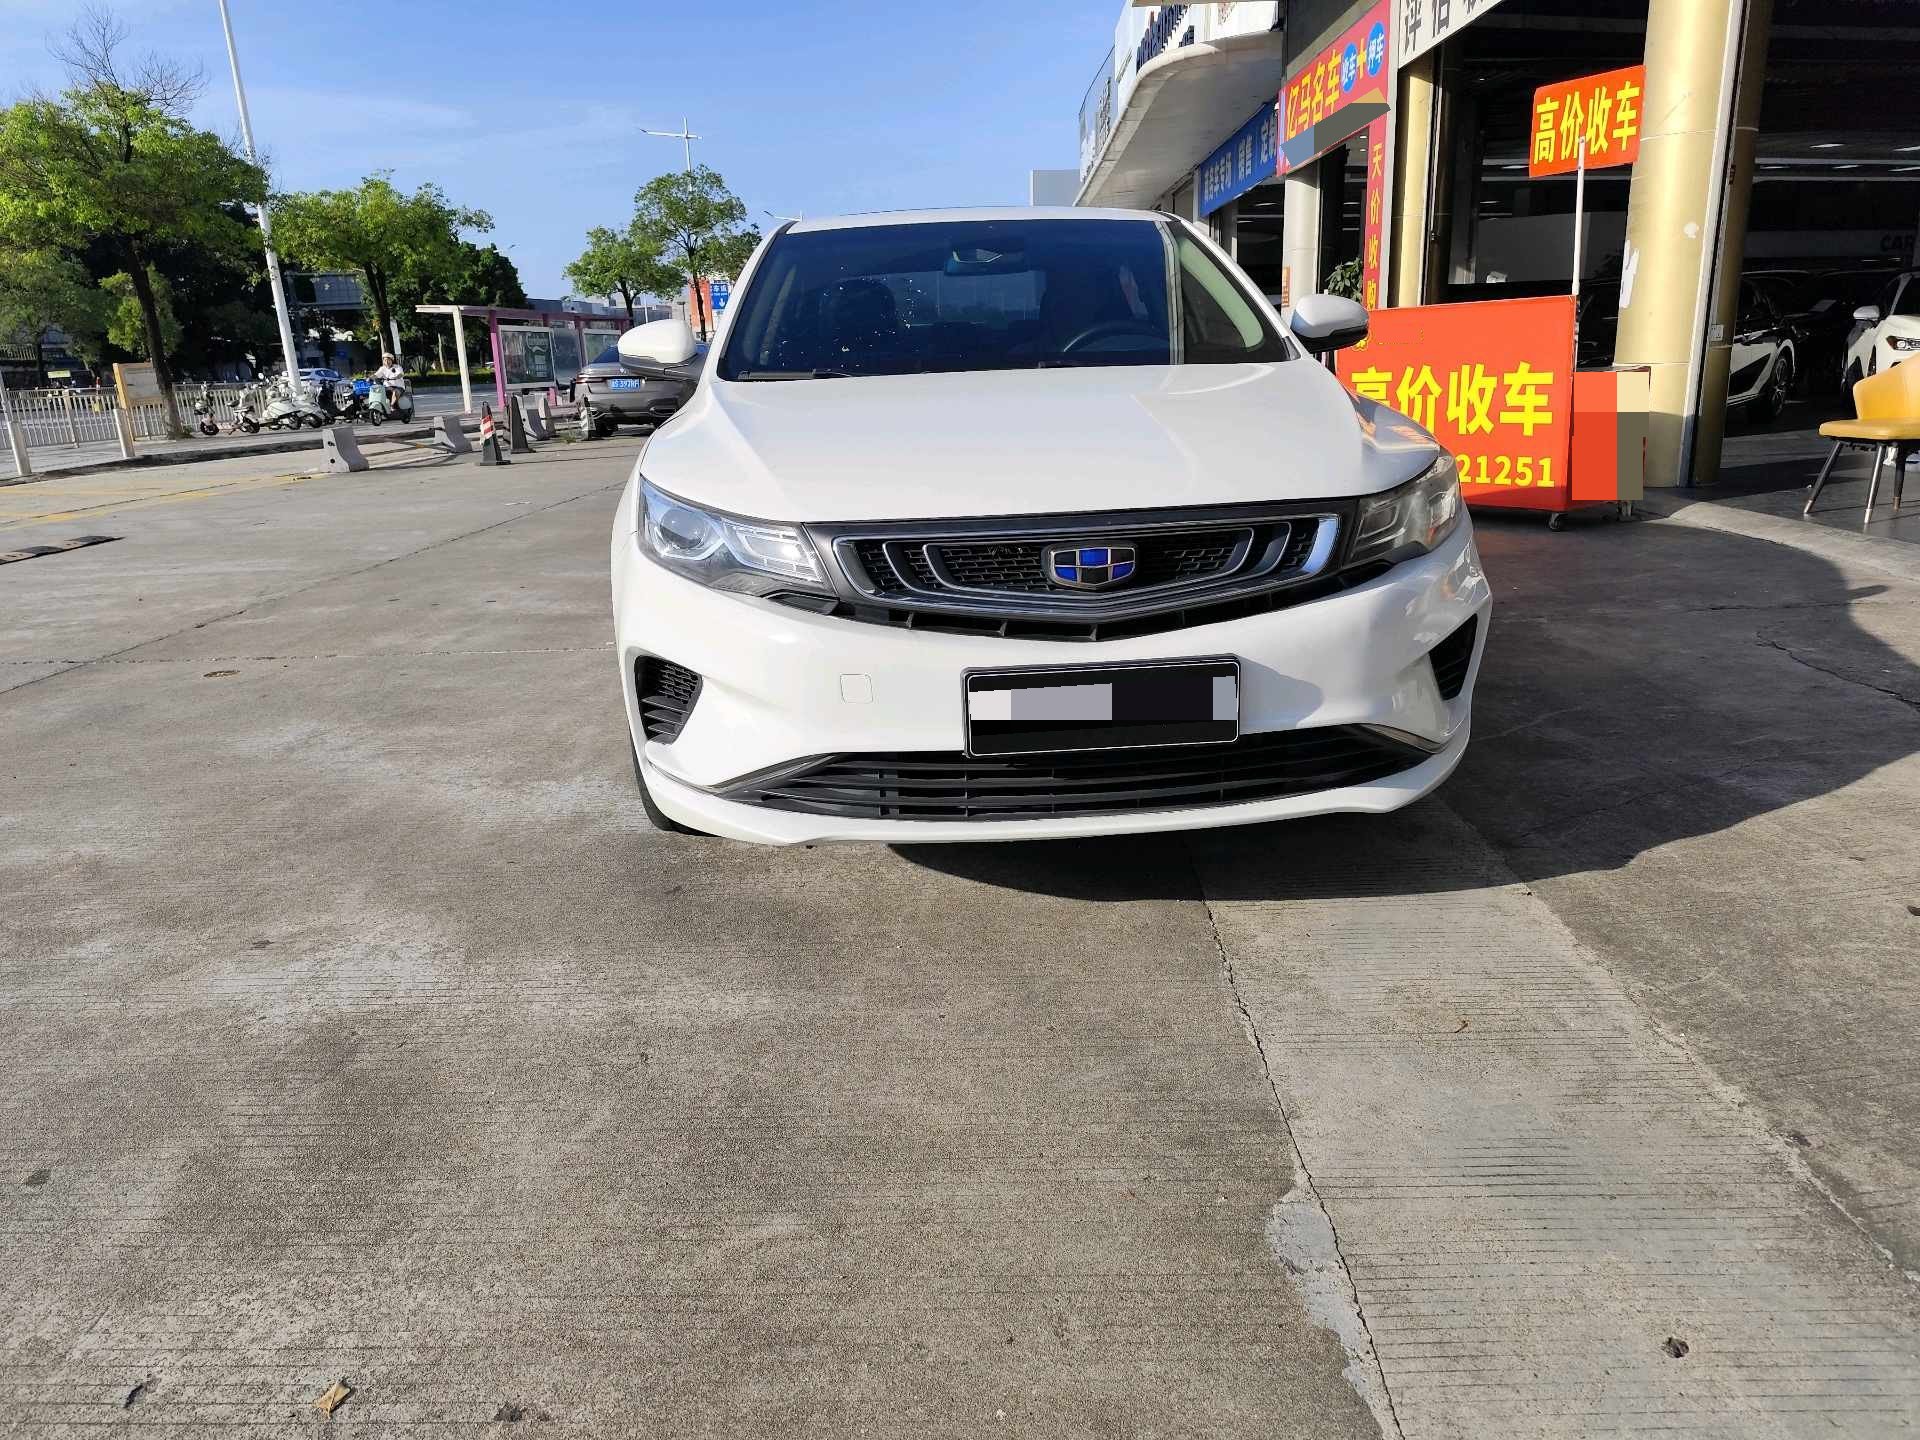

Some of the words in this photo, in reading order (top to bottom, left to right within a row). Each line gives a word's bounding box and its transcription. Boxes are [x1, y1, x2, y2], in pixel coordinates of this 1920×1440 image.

[1287, 49, 1342, 142] 亿马名车
[1533, 80, 1640, 165] 高价收车
[1366, 143, 1384, 309] 天价收购
[1352, 361, 1554, 437] 高价收车
[1456, 454, 1555, 488] 21251
